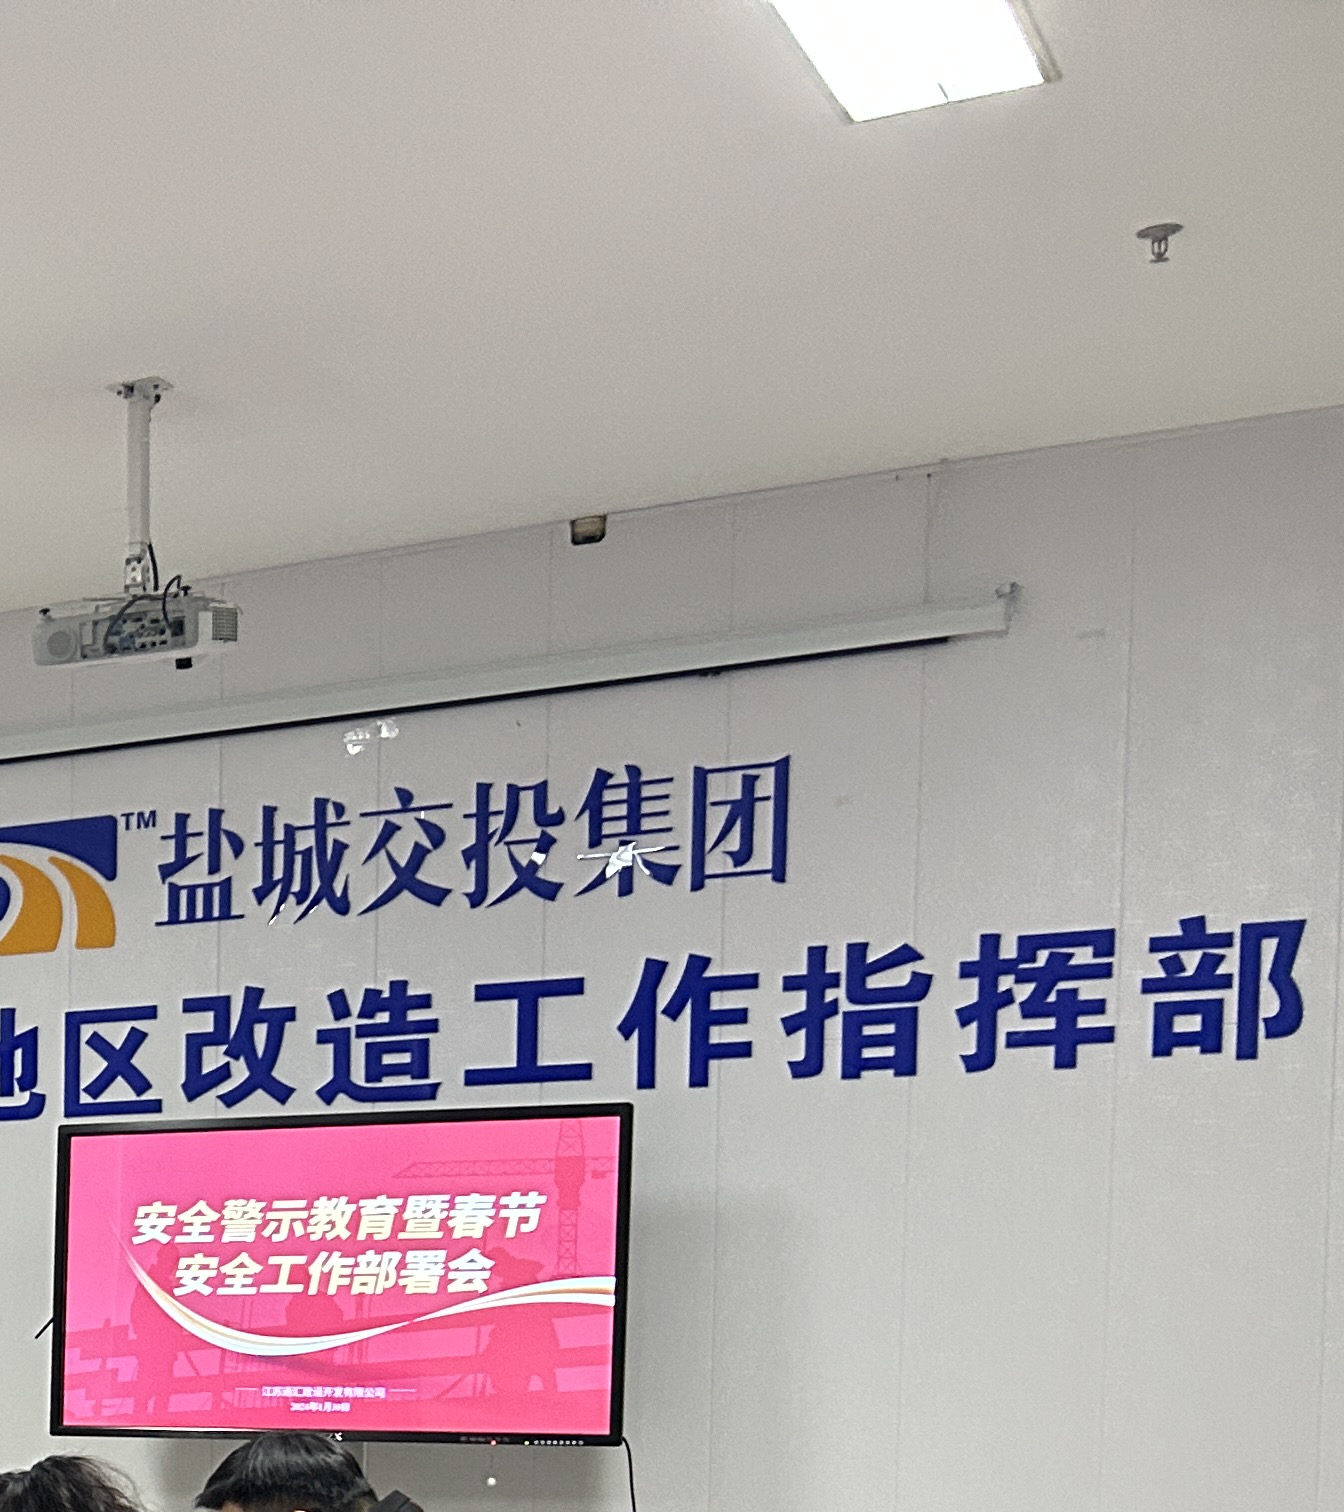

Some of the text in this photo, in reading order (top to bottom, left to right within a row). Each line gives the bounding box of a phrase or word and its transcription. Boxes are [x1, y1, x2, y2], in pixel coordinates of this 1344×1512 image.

[154, 753, 792, 931] 盐城交投集团
[130, 1191, 547, 1247] 安全警示教育暨春节
[173, 1248, 495, 1297] 安全工作部署会
